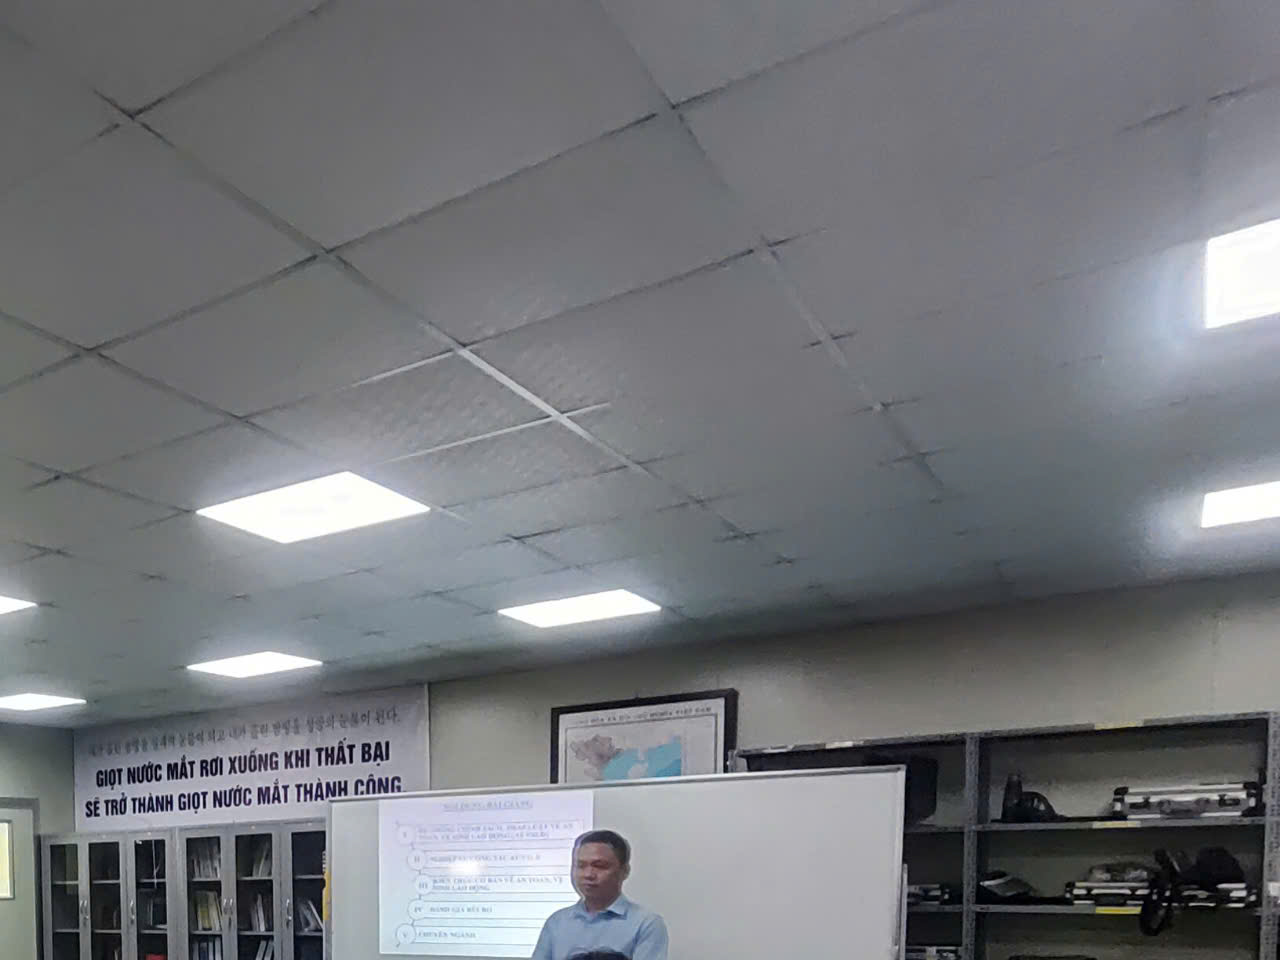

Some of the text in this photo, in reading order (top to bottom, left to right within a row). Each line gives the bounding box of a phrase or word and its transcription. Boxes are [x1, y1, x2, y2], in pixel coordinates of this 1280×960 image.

[96, 737, 390, 790] GIỌT NƯỚC MẮT RƠI XUỐNG KHI THẤT BẠI
[85, 797, 100, 818] SẼ
[104, 792, 127, 816] TRỞ
[131, 793, 173, 814] THÀNH
[178, 791, 208, 814] GIỌT
[213, 785, 252, 808] NƯỚC
[257, 778, 290, 805] MẮT
[295, 777, 348, 803] THÀNH
